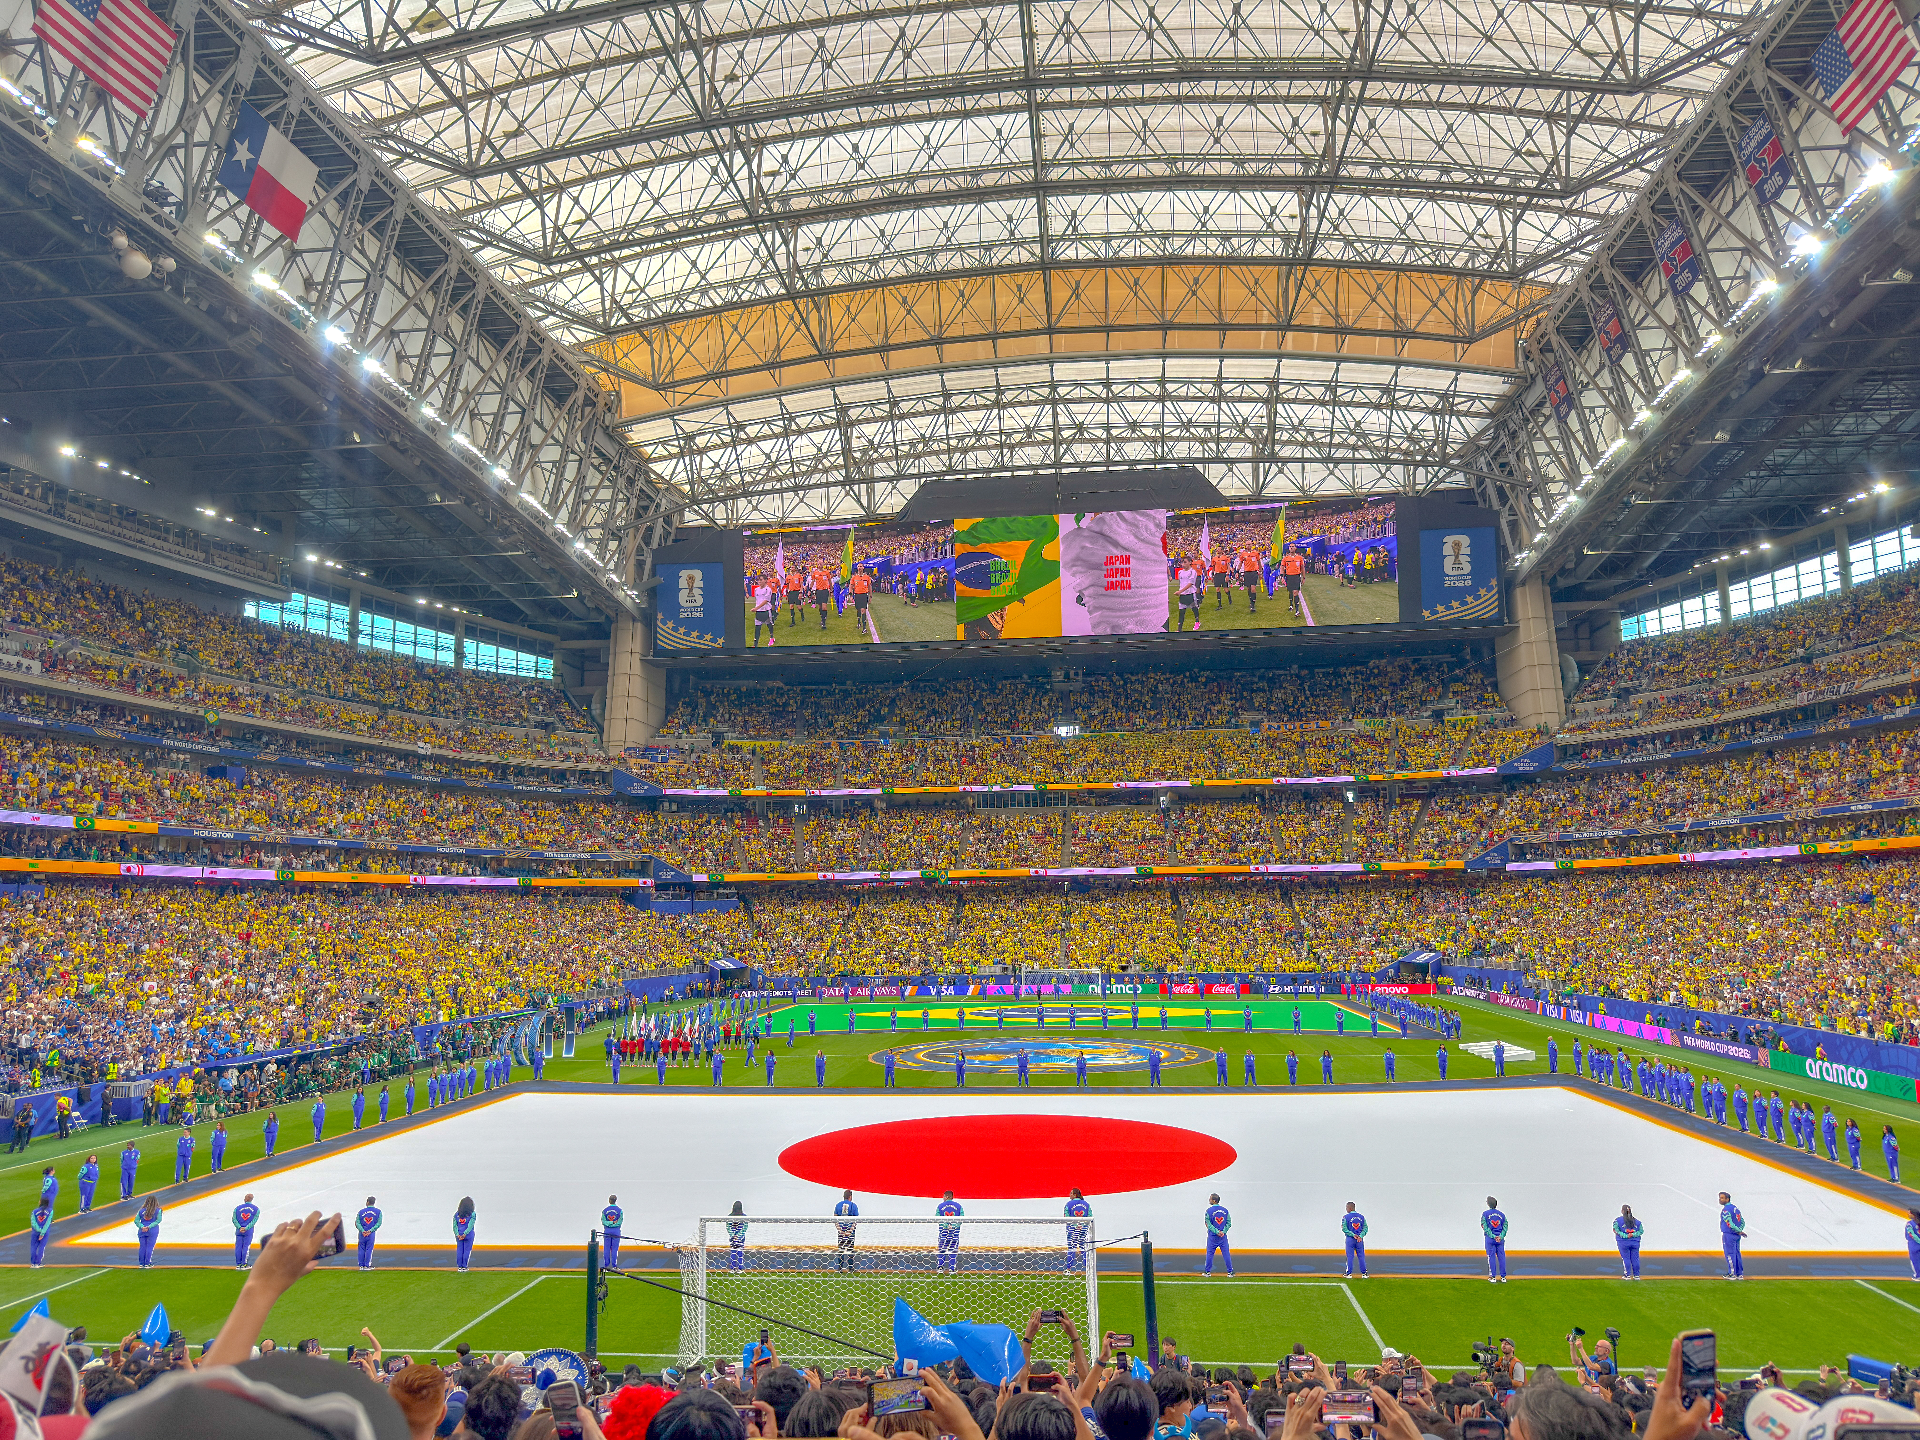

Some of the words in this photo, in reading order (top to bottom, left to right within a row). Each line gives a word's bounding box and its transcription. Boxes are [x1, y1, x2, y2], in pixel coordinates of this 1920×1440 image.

[1740, 122, 1770, 160] CHAMPIONS
[1764, 172, 1784, 198] 2016
[1674, 268, 1692, 290] 2015
[990, 560, 1018, 571] BRAZIL
[1104, 554, 1130, 566] JAPAN
[990, 572, 1018, 584] BRAZIL
[1104, 567, 1131, 578] JAPAN
[990, 584, 1018, 596] BRAZIL
[1104, 580, 1131, 592] JAPAN
[1752, 735, 1784, 744] HOUSTON
[1708, 818, 1740, 826] HOUSTON
[193, 830, 234, 838] HOUSTON
[1545, 1004, 1558, 1018] VISA
[1569, 1009, 1583, 1024] VISA
[1684, 1036, 1696, 1048] FIFA
[1696, 1038, 1715, 1051] WORLD
[1716, 1042, 1727, 1054] CUP
[1806, 1058, 1868, 1089] aramco
